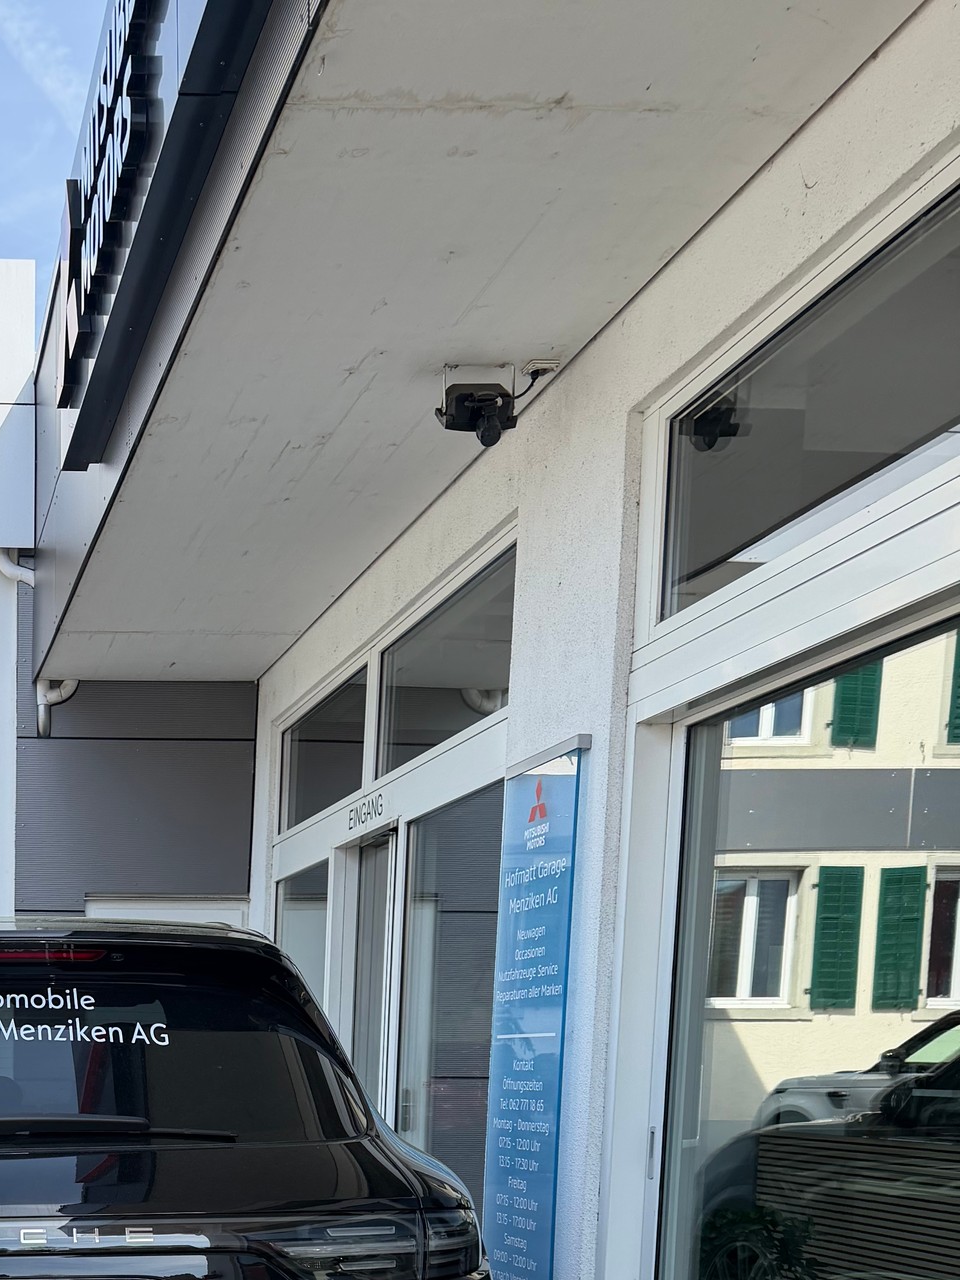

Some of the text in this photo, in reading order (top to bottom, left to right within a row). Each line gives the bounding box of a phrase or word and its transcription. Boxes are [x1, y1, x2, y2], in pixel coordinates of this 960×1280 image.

[81, 54, 132, 316] MOTORS
[348, 793, 384, 831] EINGANG
[524, 822, 550, 841] MITSUBISHI
[526, 835, 546, 851] MOTORS
[504, 857, 567, 888] Hofmatt Garage
[509, 886, 558, 914] Menziken AG
[516, 926, 546, 941] Neuwagen
[514, 946, 546, 961] Occasionen
[498, 962, 559, 982] Nutzfahrzeuge Service
[496, 982, 563, 1004] Reparaturen aller Marken
[130, 1022, 171, 1046] AG
[513, 1059, 534, 1071] Kontakt
[502, 1076, 543, 1093] Öffnungszeiten
[536, 1099, 544, 1112] 65
[493, 1117, 513, 1133] Montag
[517, 1119, 550, 1136] Donnerstag
[530, 1140, 541, 1152] Uhr
[529, 1160, 539, 1172] Uhr
[508, 1176, 527, 1193] Freitag
[527, 1199, 538, 1212] Uhr
[526, 1218, 537, 1231] Uhr
[503, 1232, 527, 1252] Samstag
[526, 1258, 538, 1272] Uhr
